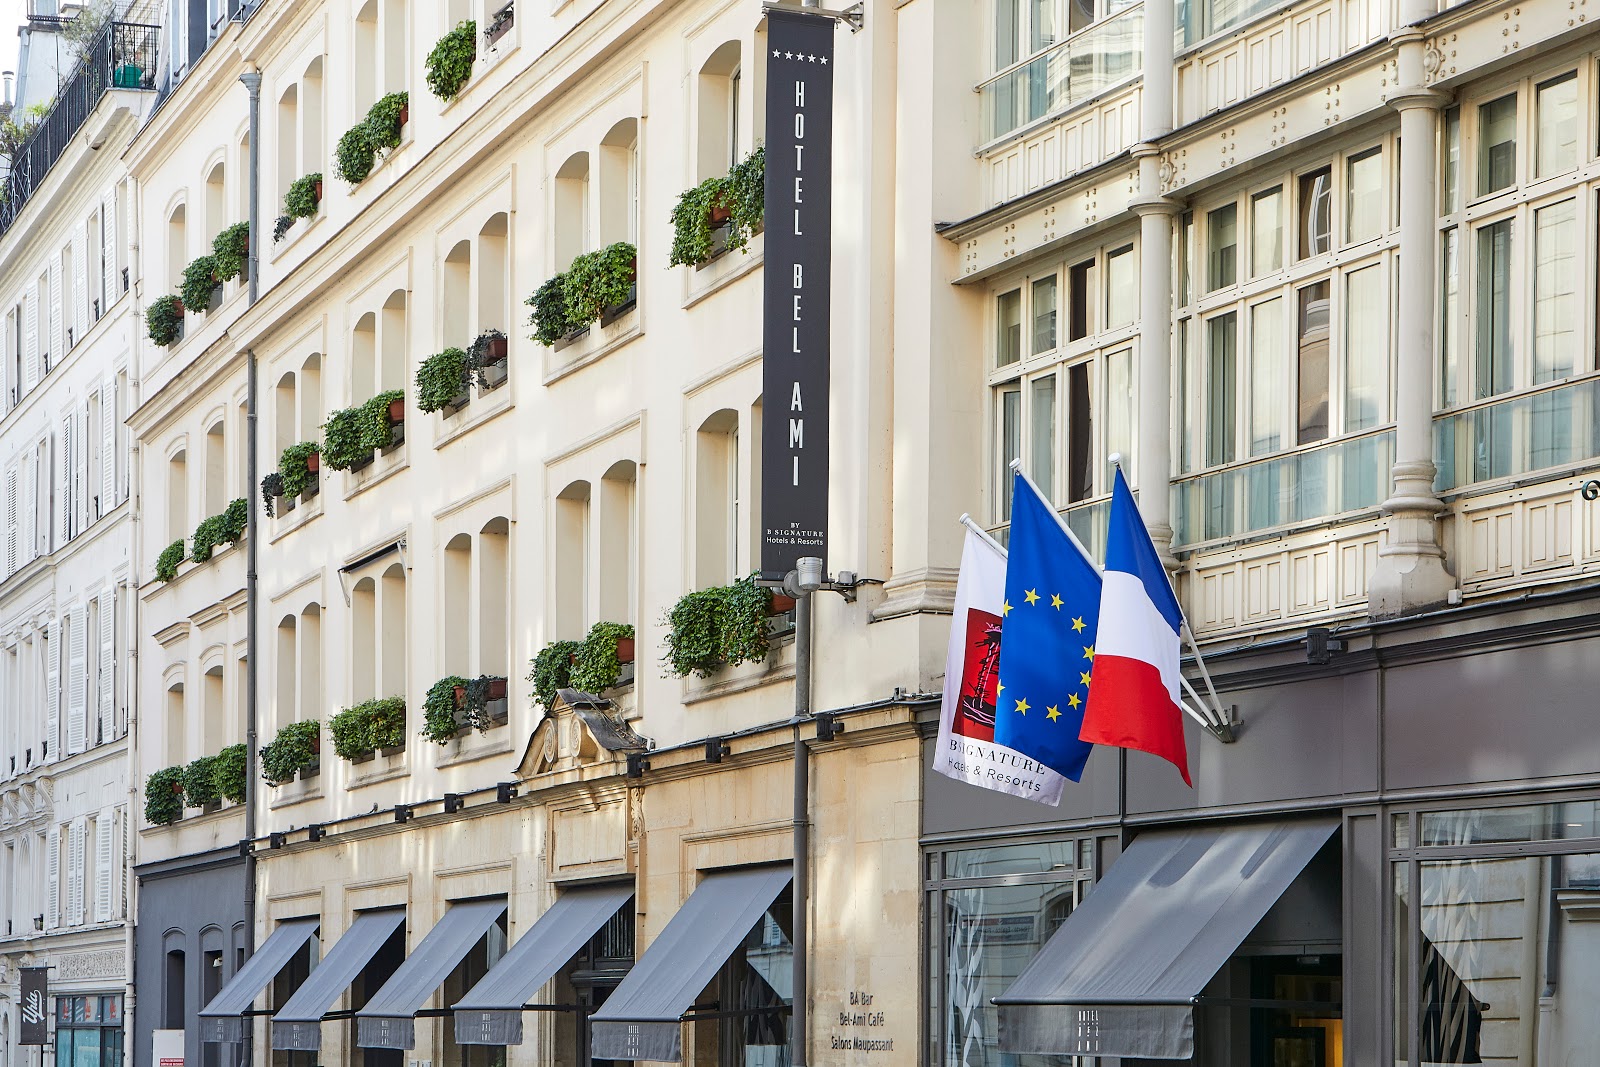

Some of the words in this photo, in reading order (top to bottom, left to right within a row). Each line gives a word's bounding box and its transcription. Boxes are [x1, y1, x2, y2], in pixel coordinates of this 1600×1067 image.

[794, 80, 805, 236] HOTEL
[793, 263, 803, 354] BEL
[789, 381, 804, 486] AMI
[766, 536, 788, 544] Hotels
[797, 537, 823, 545] Resorts
[774, 529, 823, 537] SIGNATURE
[973, 765, 982, 776] &
[986, 768, 1041, 792] Resorts
[850, 991, 859, 1005] BA
[861, 991, 874, 1006] Bar
[839, 1011, 866, 1027] Bel-Ami
[867, 1011, 884, 1026] Café
[831, 1035, 851, 1049] Salons
[852, 1036, 893, 1053] Maupassant
